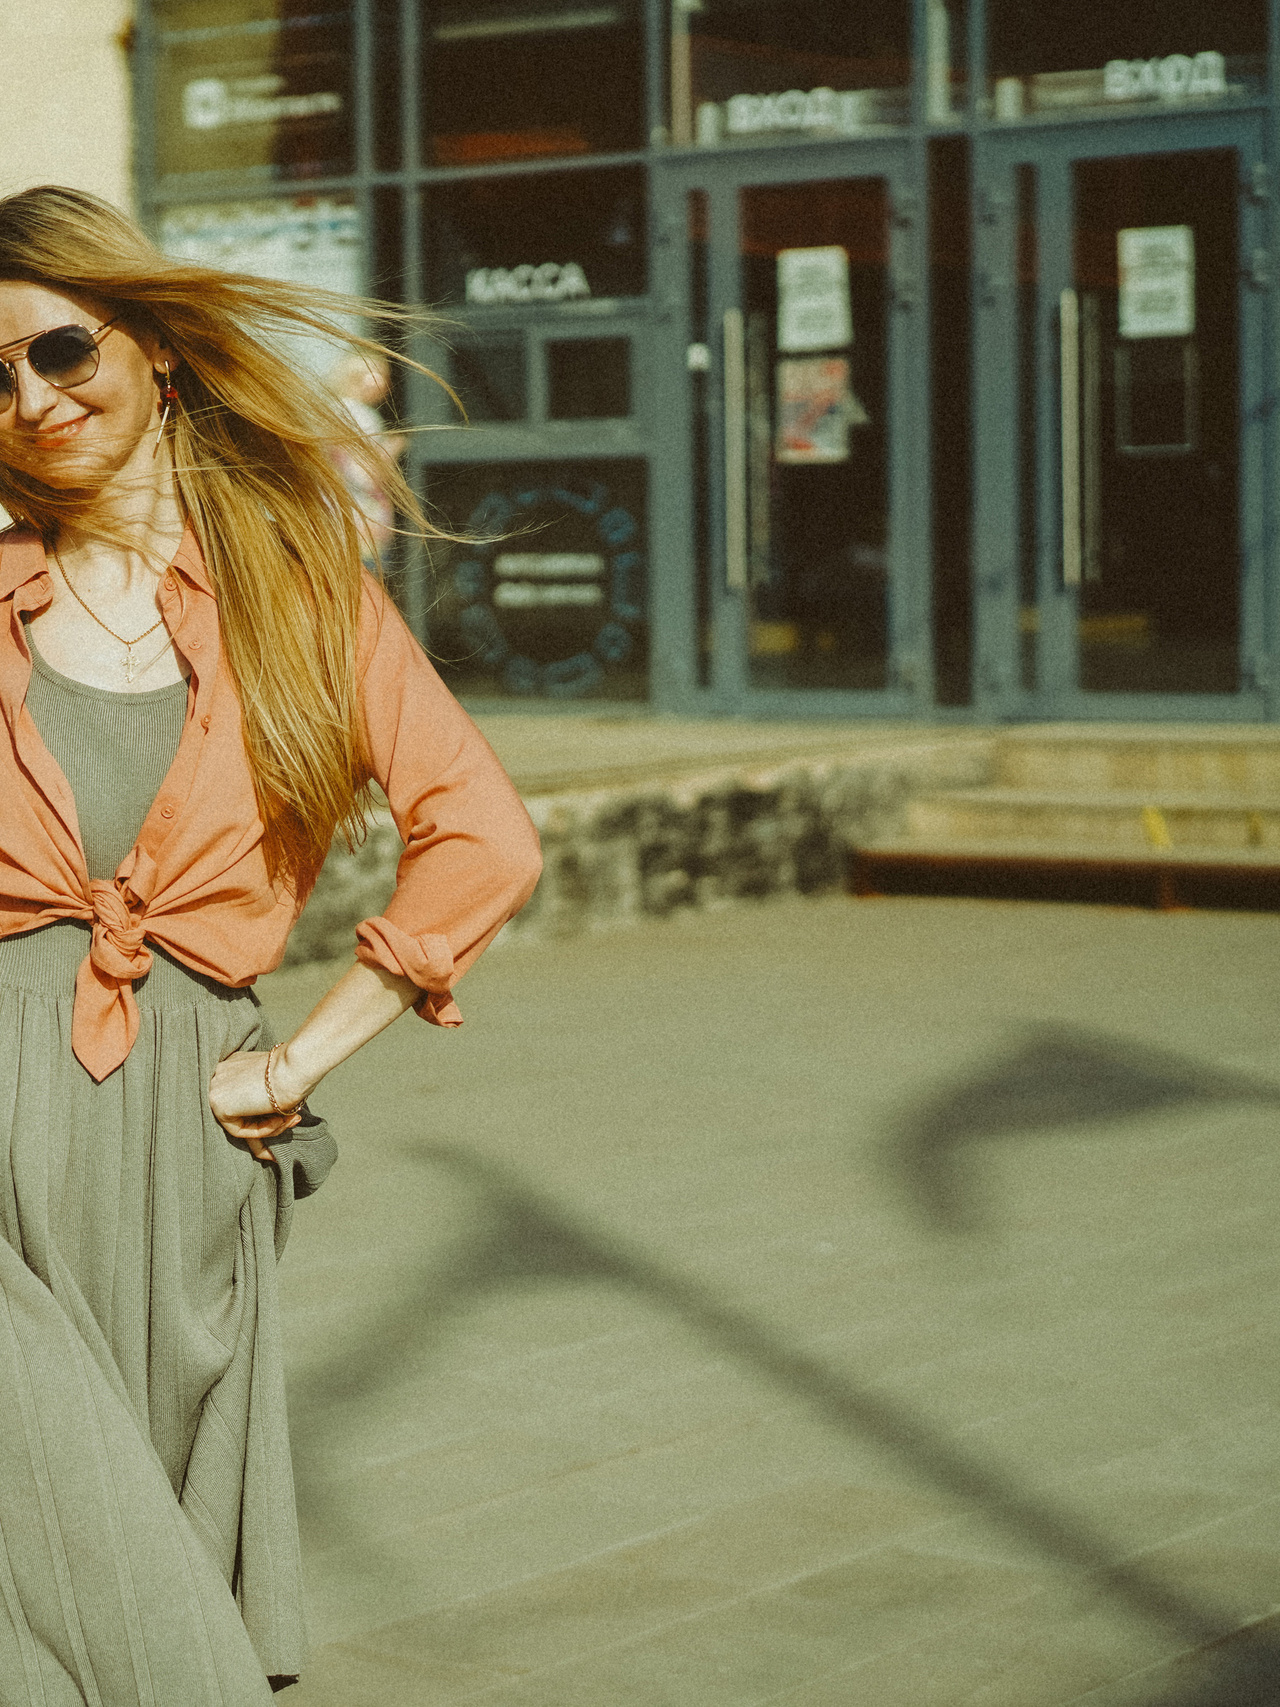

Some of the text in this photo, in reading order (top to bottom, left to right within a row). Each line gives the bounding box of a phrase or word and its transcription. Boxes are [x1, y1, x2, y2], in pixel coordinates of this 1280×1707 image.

[1105, 51, 1227, 98] ВХОД
[728, 87, 837, 132] ВХОД
[466, 262, 590, 303] КАССА
